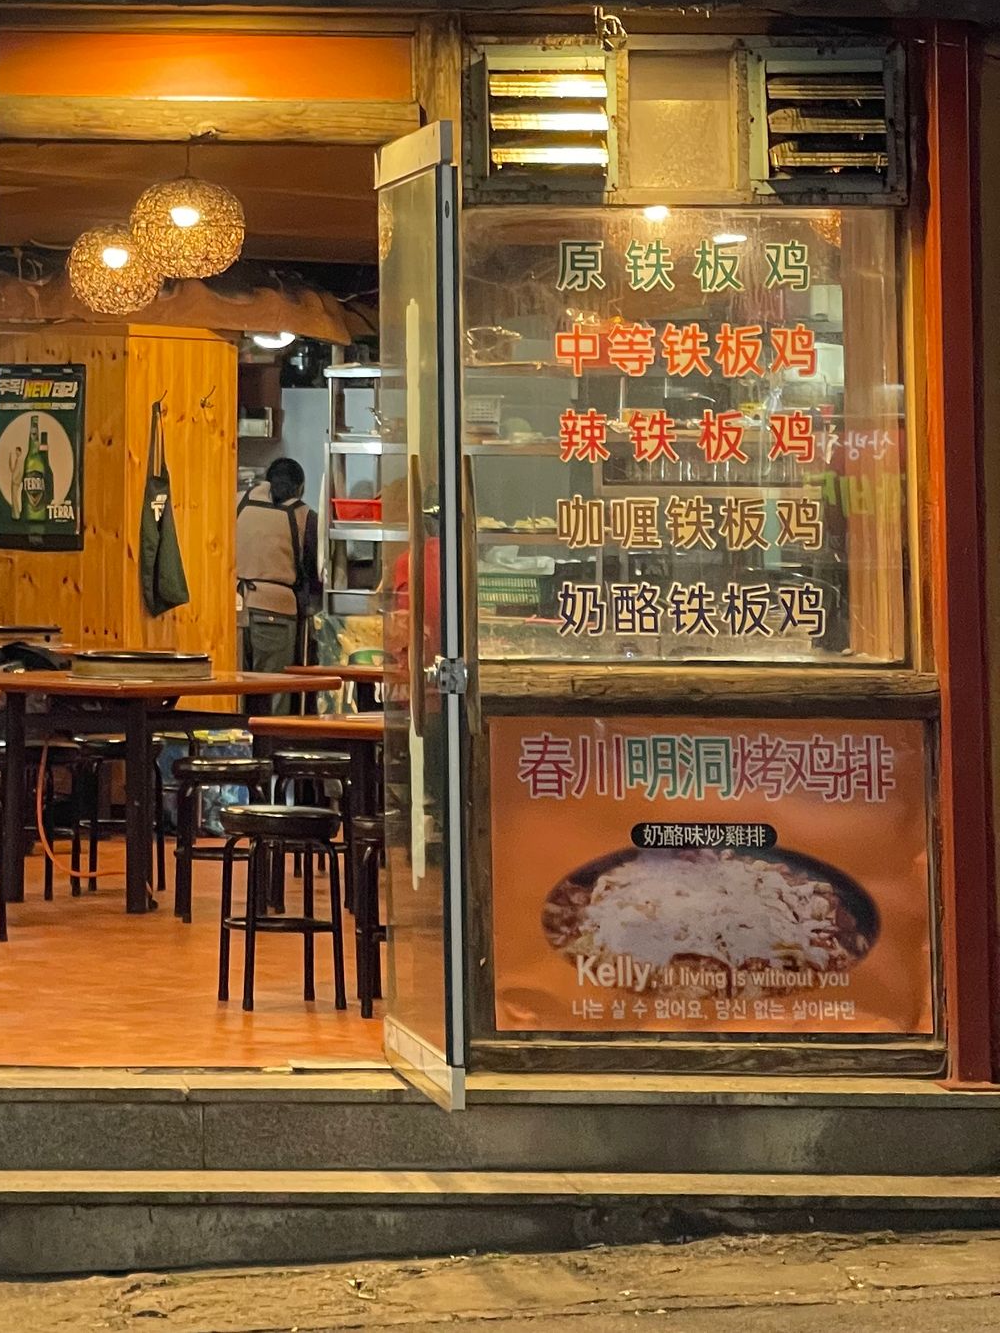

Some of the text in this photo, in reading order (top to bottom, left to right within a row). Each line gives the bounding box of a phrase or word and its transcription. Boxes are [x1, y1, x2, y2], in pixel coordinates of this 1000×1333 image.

[556, 239, 811, 292] 原铁板鸡
[555, 323, 817, 378] 中等铁板鸡
[24, 379, 54, 399] NEW
[558, 408, 815, 465] 辣铁板鸡
[46, 504, 74, 520] TERRA
[556, 494, 823, 552] 咖喱铁板鸡
[558, 582, 827, 640] 奶酪铁板鸡
[518, 732, 896, 803] 春川明洞烤鸡排
[576, 954, 658, 992] Kelly,
[680, 967, 728, 989] living
[732, 967, 747, 987] is
[752, 967, 813, 987] without
[818, 970, 850, 989] you
[572, 999, 604, 1020] 나는
[611, 999, 626, 1020] 살
[632, 1000, 648, 1020] 수
[715, 999, 747, 1021] 당신
[753, 1000, 786, 1021] 없는
